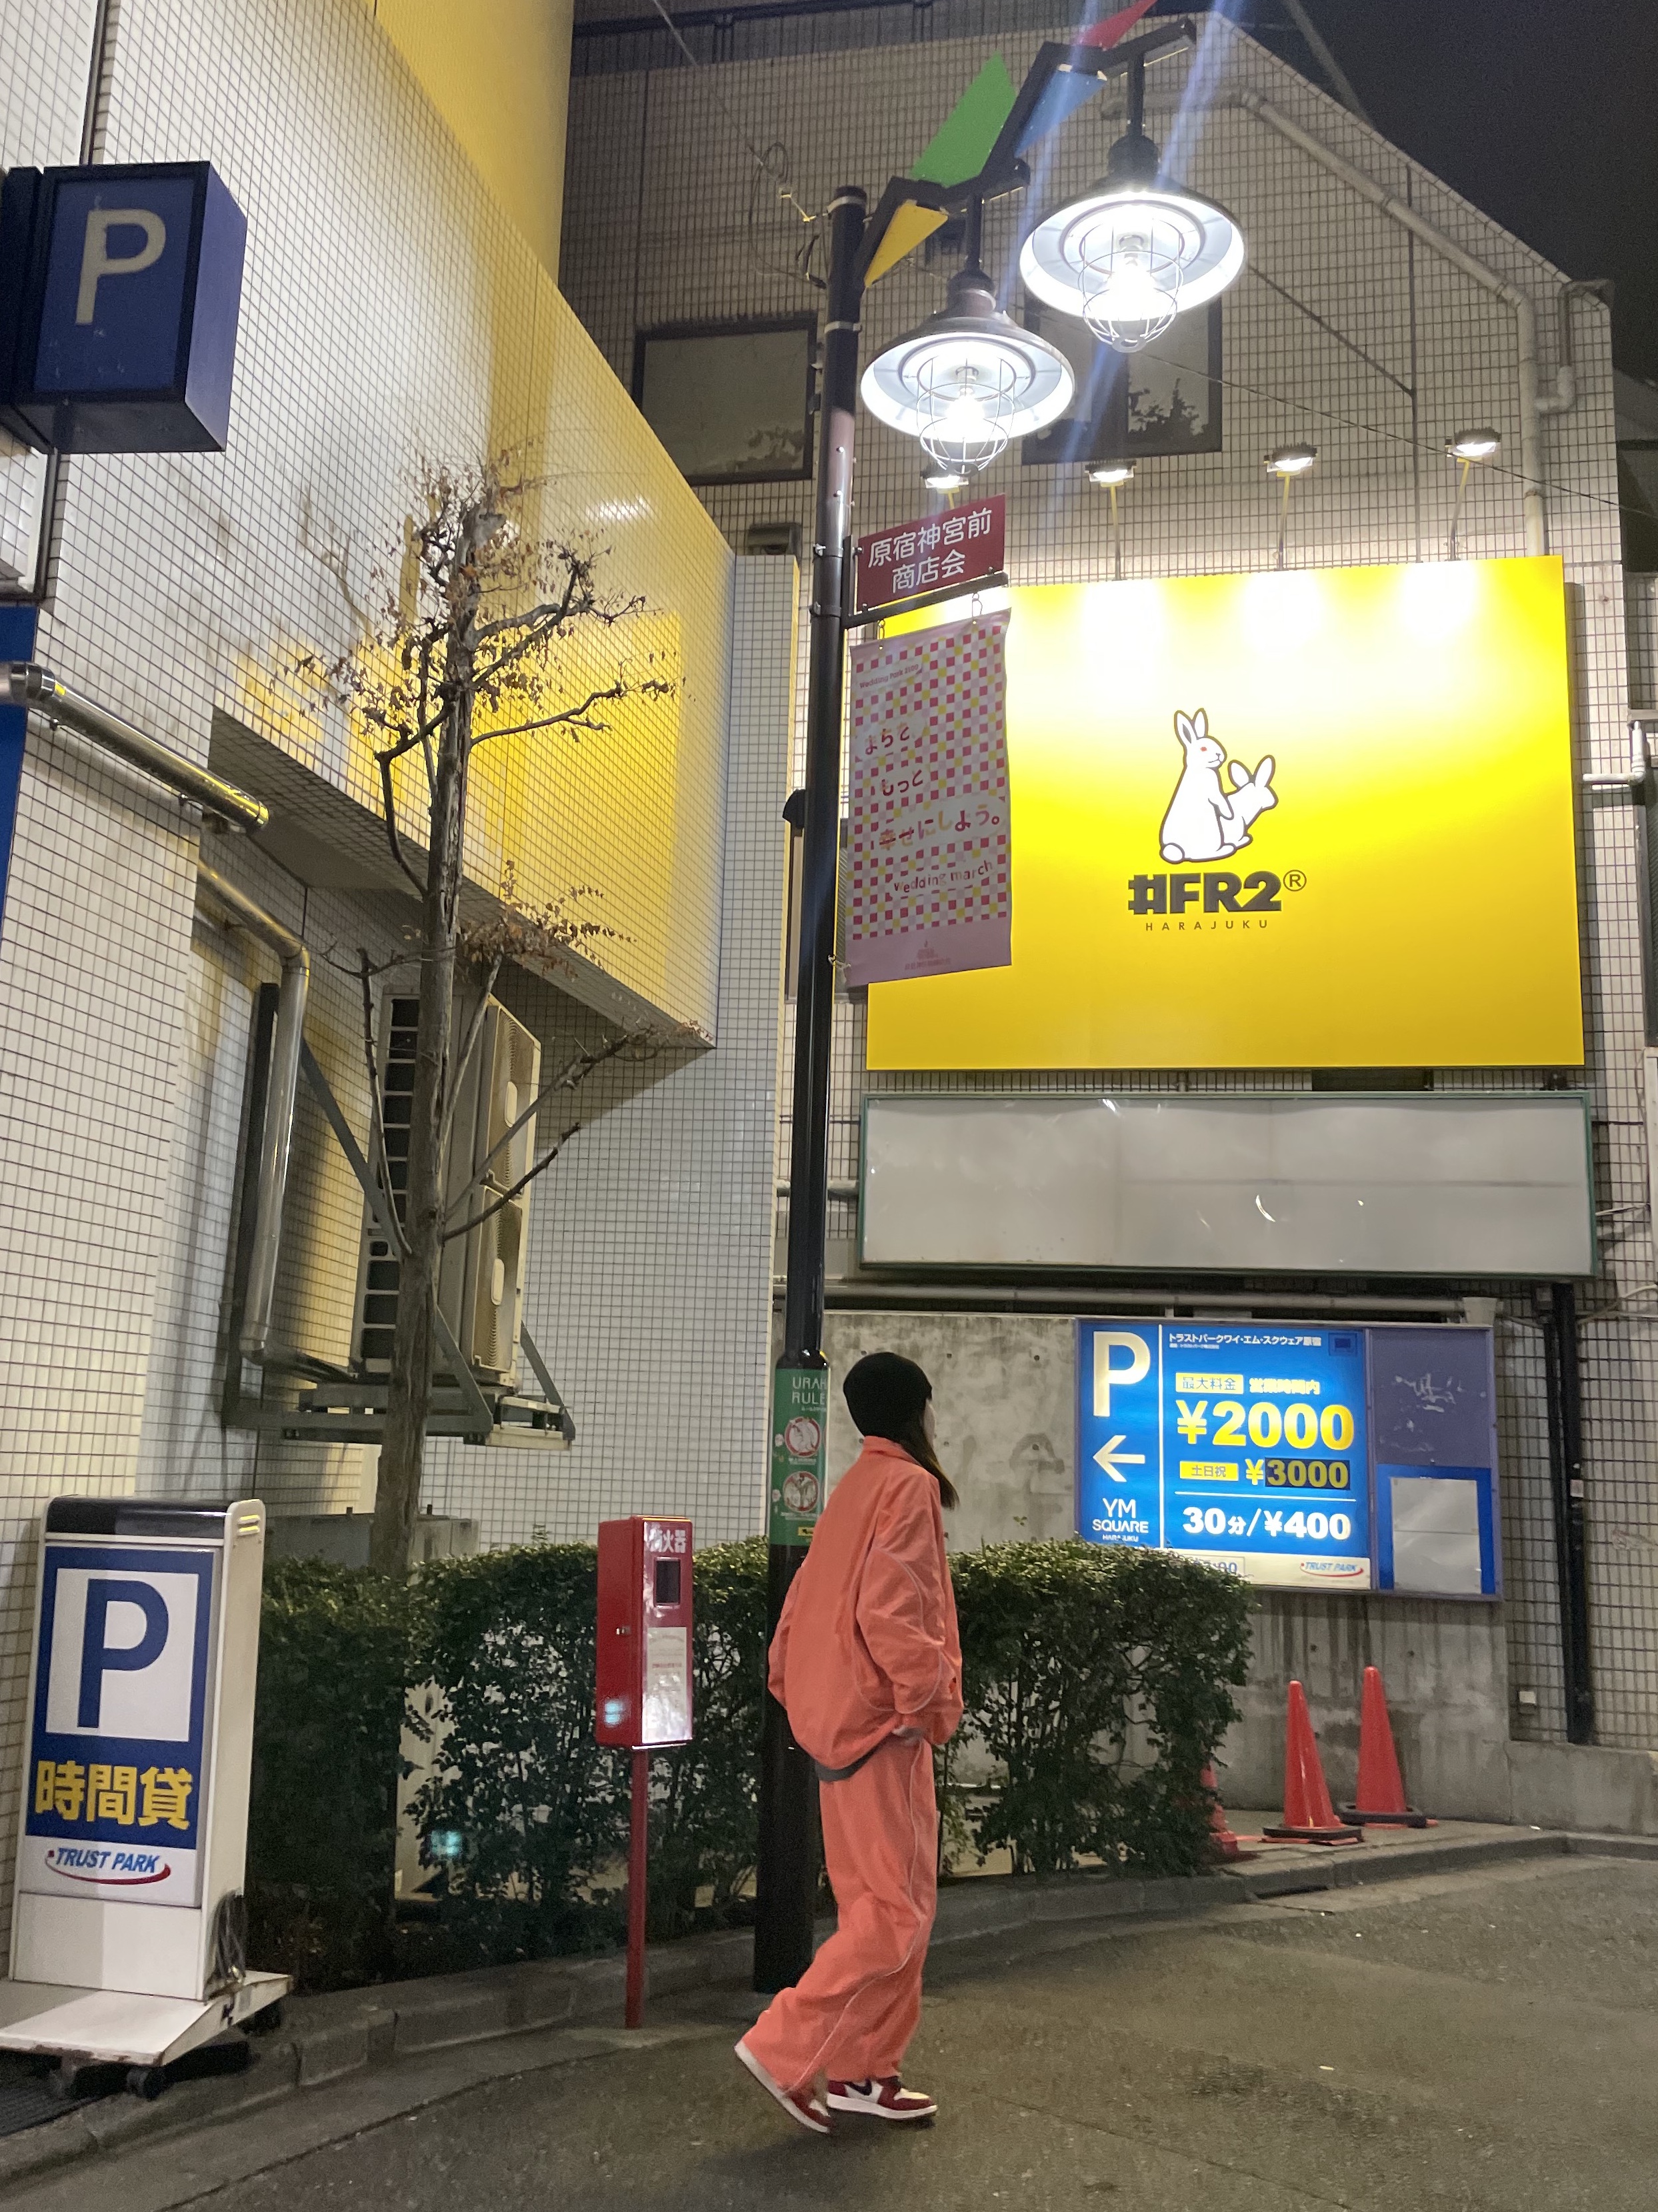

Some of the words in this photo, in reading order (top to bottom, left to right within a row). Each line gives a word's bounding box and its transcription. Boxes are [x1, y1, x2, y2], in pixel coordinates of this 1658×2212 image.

[74, 208, 167, 326] P
[868, 507, 992, 568] 原宿神宮前
[892, 549, 965, 594] 商店会
[859, 676, 889, 688] Wedding
[889, 670, 903, 679] Park
[879, 804, 1000, 851] 幸せにしよう。
[951, 860, 993, 881] march
[1145, 920, 1268, 932] HARAJUKU
[1093, 1330, 1151, 1417] P
[1182, 1376, 1237, 1390] 最大料金
[1176, 1399, 1355, 1450] ¥2000
[1191, 1464, 1226, 1478] 土日祝
[1245, 1458, 1349, 1489] ¥3000
[1102, 1498, 1136, 1518] YM
[1092, 1518, 1149, 1534] SQUARE
[1305, 1562, 1333, 1570] TRUST
[1333, 1563, 1357, 1572] PARK
[77, 1578, 169, 1729] P
[35, 1760, 193, 1831] 時間貸
[56, 1847, 111, 1869] TRUST
[111, 1852, 160, 1873] PARK
